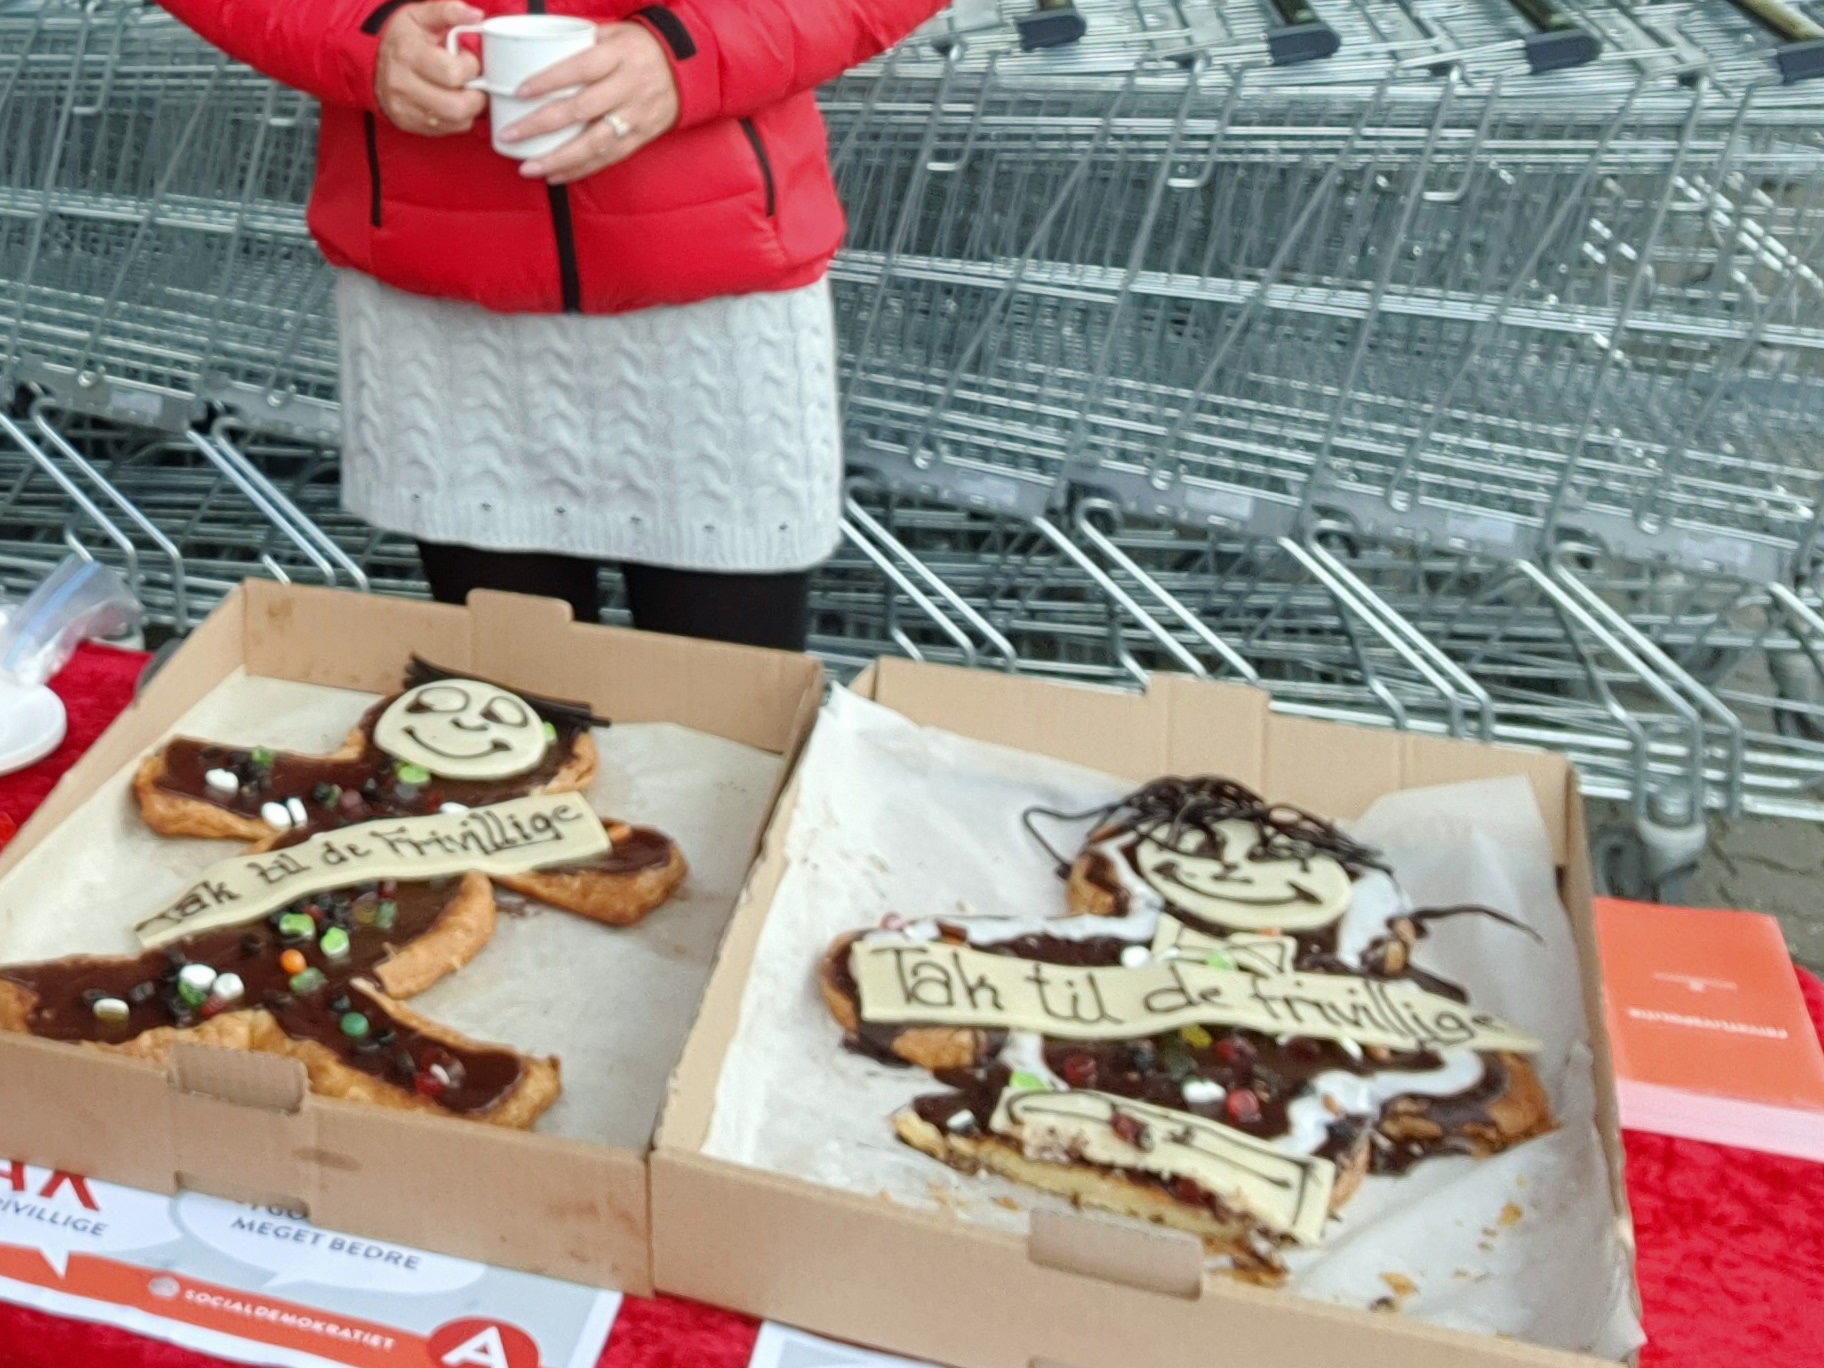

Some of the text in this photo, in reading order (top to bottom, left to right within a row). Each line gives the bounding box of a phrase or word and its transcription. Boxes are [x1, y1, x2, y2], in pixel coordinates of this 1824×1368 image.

[321, 840, 373, 865] de
[871, 947, 1004, 1010] Tak
[1025, 962, 1123, 1025] til
[1143, 962, 1234, 1013] de
[230, 1215, 422, 1272] MEGET BEDRE
[184, 1288, 396, 1352] SOCIALDEMOKRATIET
